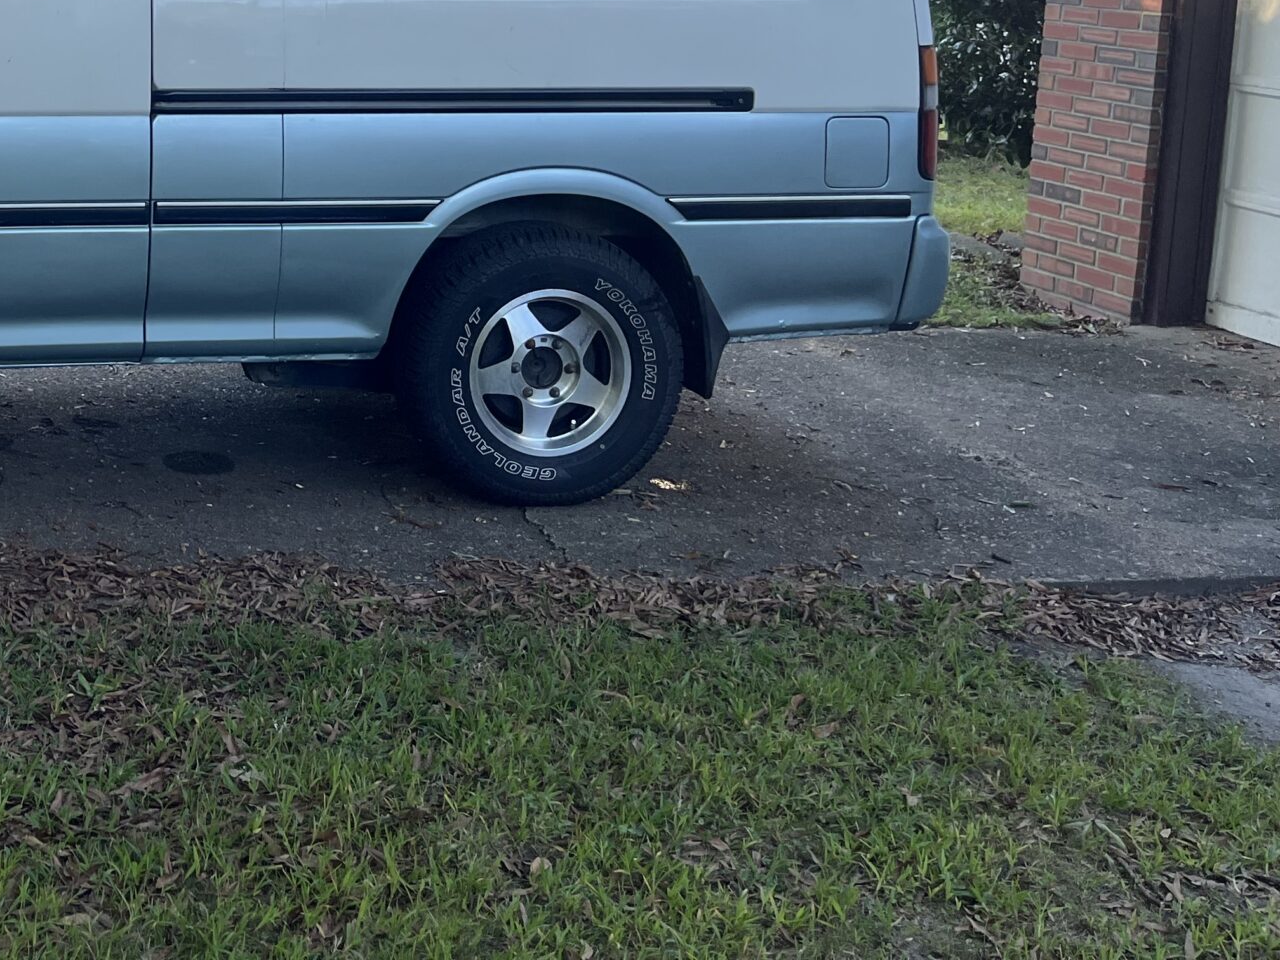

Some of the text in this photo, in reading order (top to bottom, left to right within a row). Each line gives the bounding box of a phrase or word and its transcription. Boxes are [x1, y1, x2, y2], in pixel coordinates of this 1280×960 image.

[450, 306, 557, 482] GEOLANDAR A/T
[595, 278, 657, 401] YOKOHAMA
